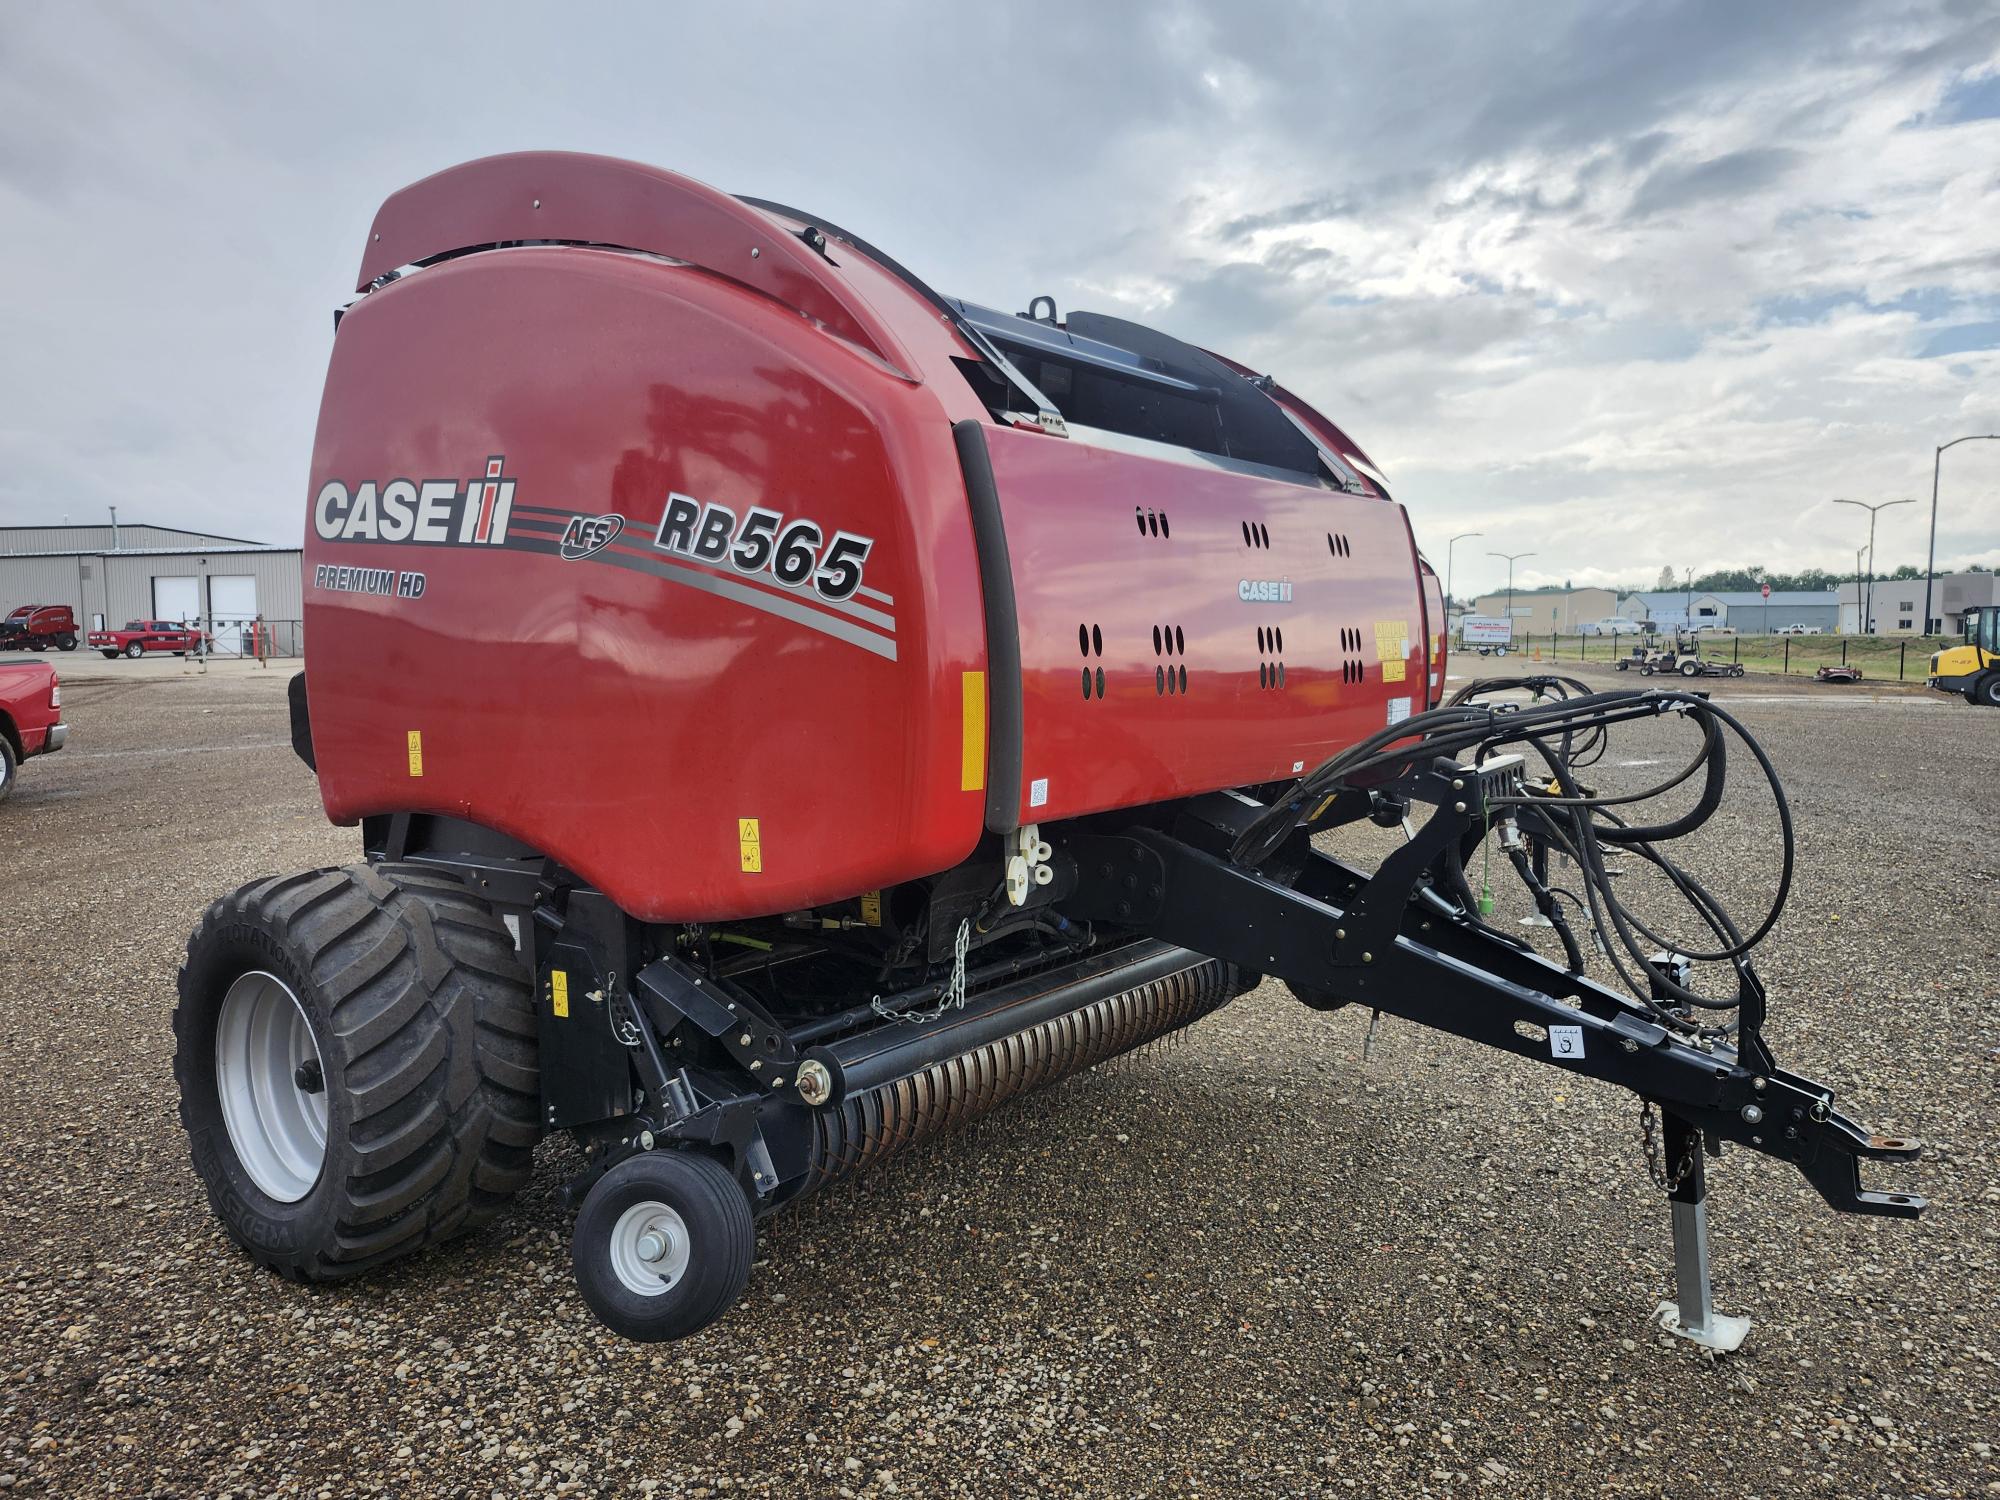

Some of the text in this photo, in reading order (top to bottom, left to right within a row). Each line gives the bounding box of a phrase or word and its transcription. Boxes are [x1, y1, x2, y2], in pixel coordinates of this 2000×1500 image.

[314, 480, 458, 542] CASE
[560, 515, 613, 550] AFS
[654, 492, 875, 603] RB565
[315, 564, 427, 599] PREMIUM HD
[1238, 579, 1280, 601] CASE
